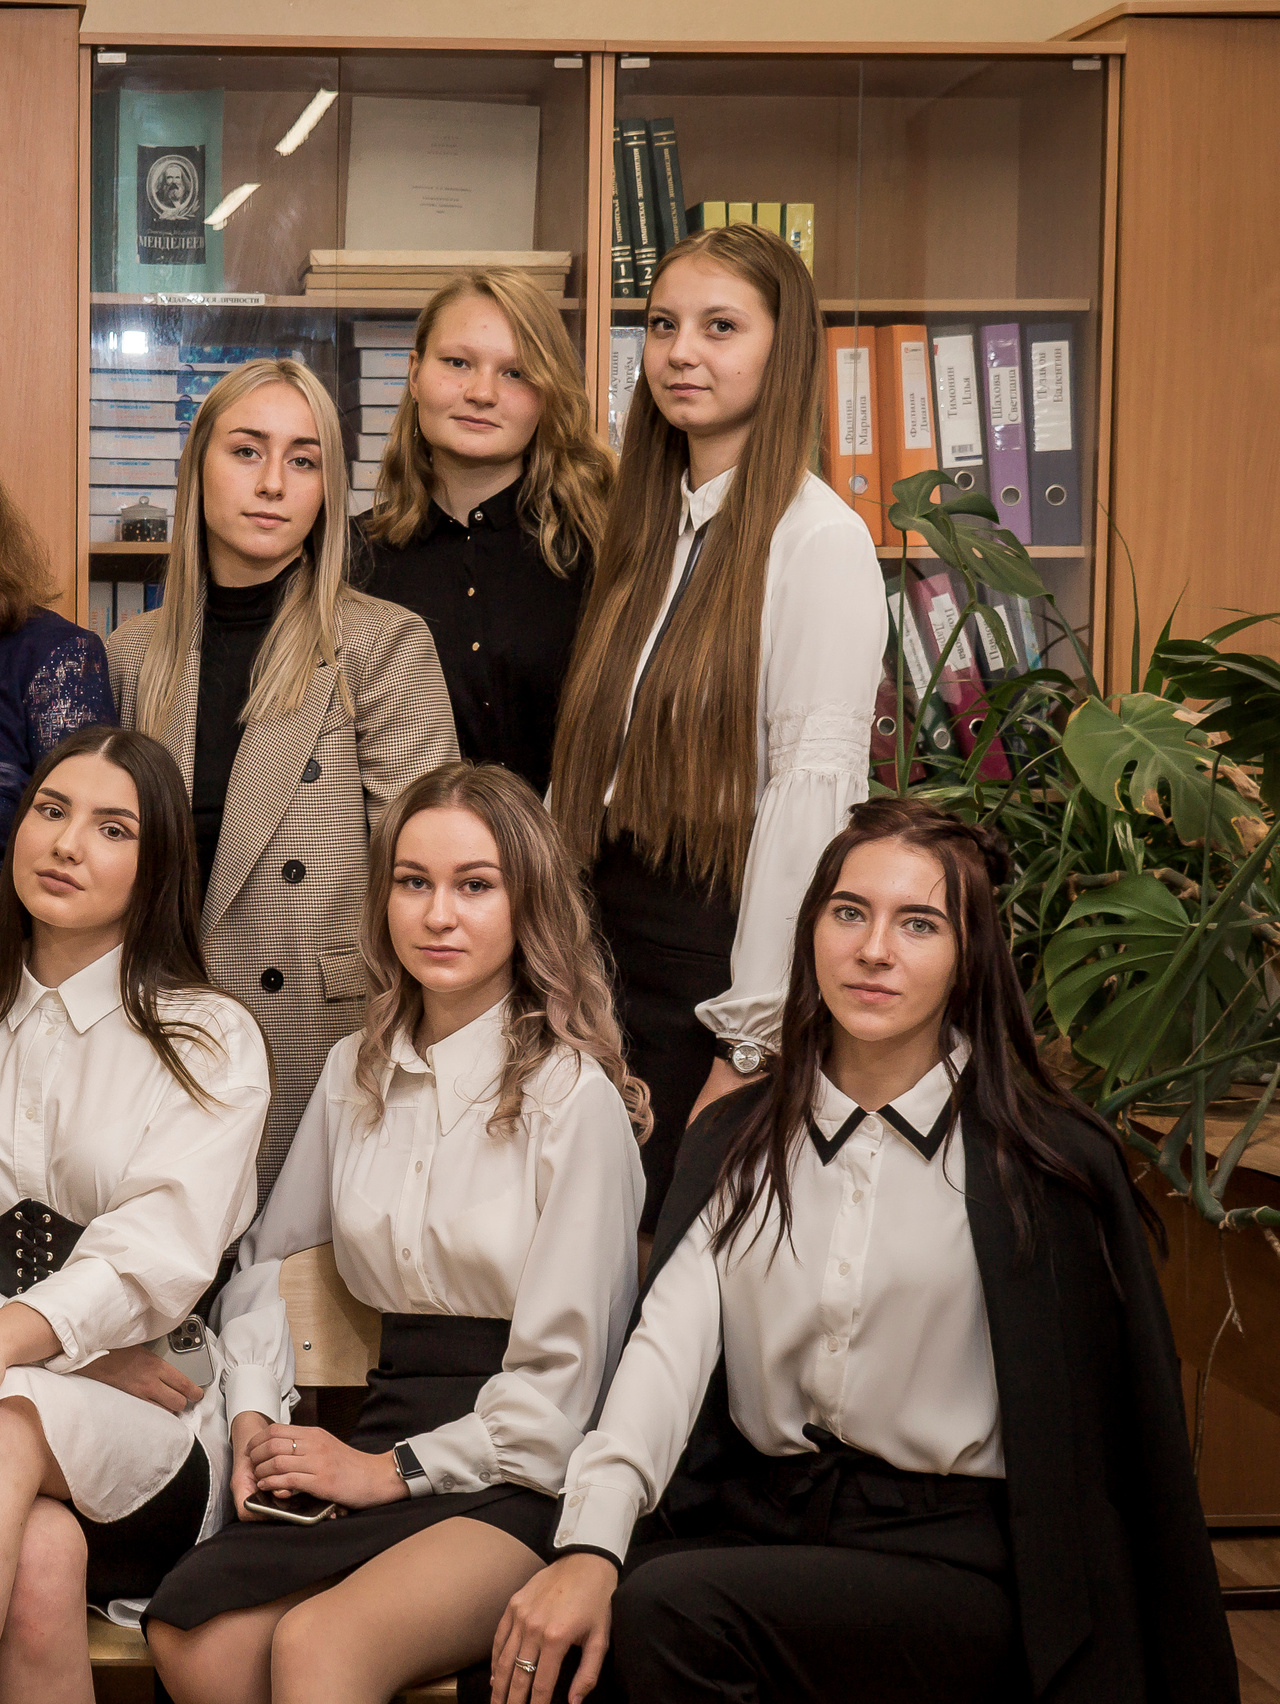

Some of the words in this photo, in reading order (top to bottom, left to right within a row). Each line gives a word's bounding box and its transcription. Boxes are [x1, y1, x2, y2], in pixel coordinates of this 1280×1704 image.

[139, 235, 205, 250] МЕНДЕЛЕЕВ
[620, 263, 625, 276] 1
[644, 267, 652, 279] 2
[624, 356, 635, 393] Артём
[946, 366, 958, 418] Тимонин
[962, 377, 972, 405] Илья
[992, 374, 1003, 419] Шахова
[1008, 369, 1018, 422] Светлана
[1053, 348, 1064, 403] Валентин
[845, 399, 854, 444] Филина
[859, 395, 871, 446] Марьяна
[909, 392, 918, 438] Филина
[920, 397, 930, 433] Диана
[944, 607, 966, 660] Поова
